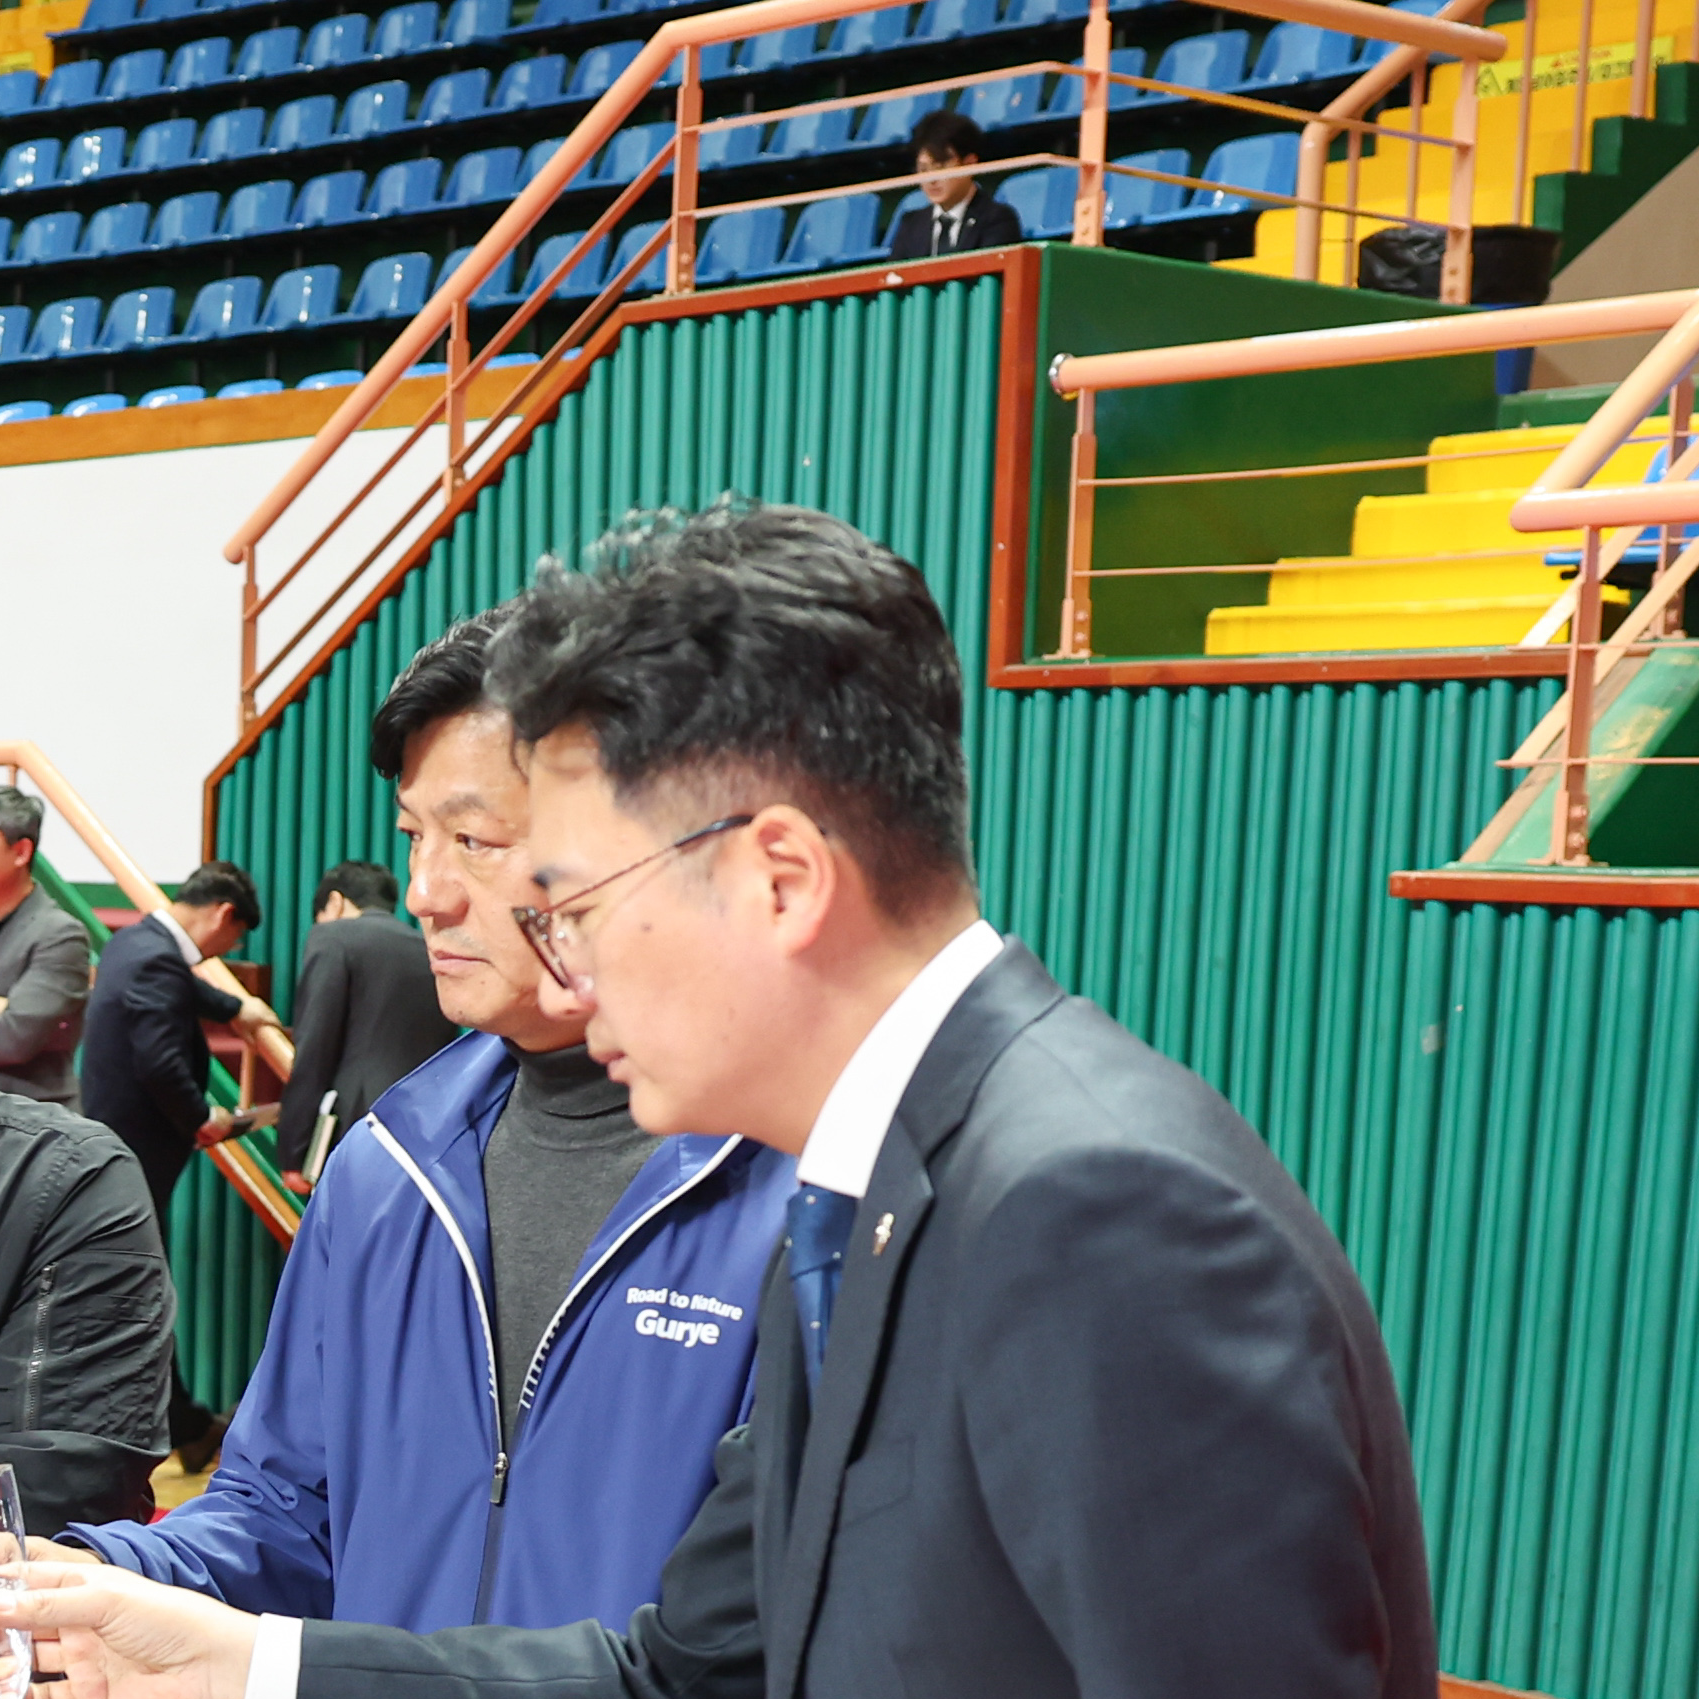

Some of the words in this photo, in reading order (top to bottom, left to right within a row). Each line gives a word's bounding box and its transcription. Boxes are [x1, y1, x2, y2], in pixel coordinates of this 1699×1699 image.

[626, 1287, 668, 1304] Road
[669, 1290, 690, 1309] to
[690, 1294, 744, 1321] Nature
[635, 1308, 721, 1348] Gurye
